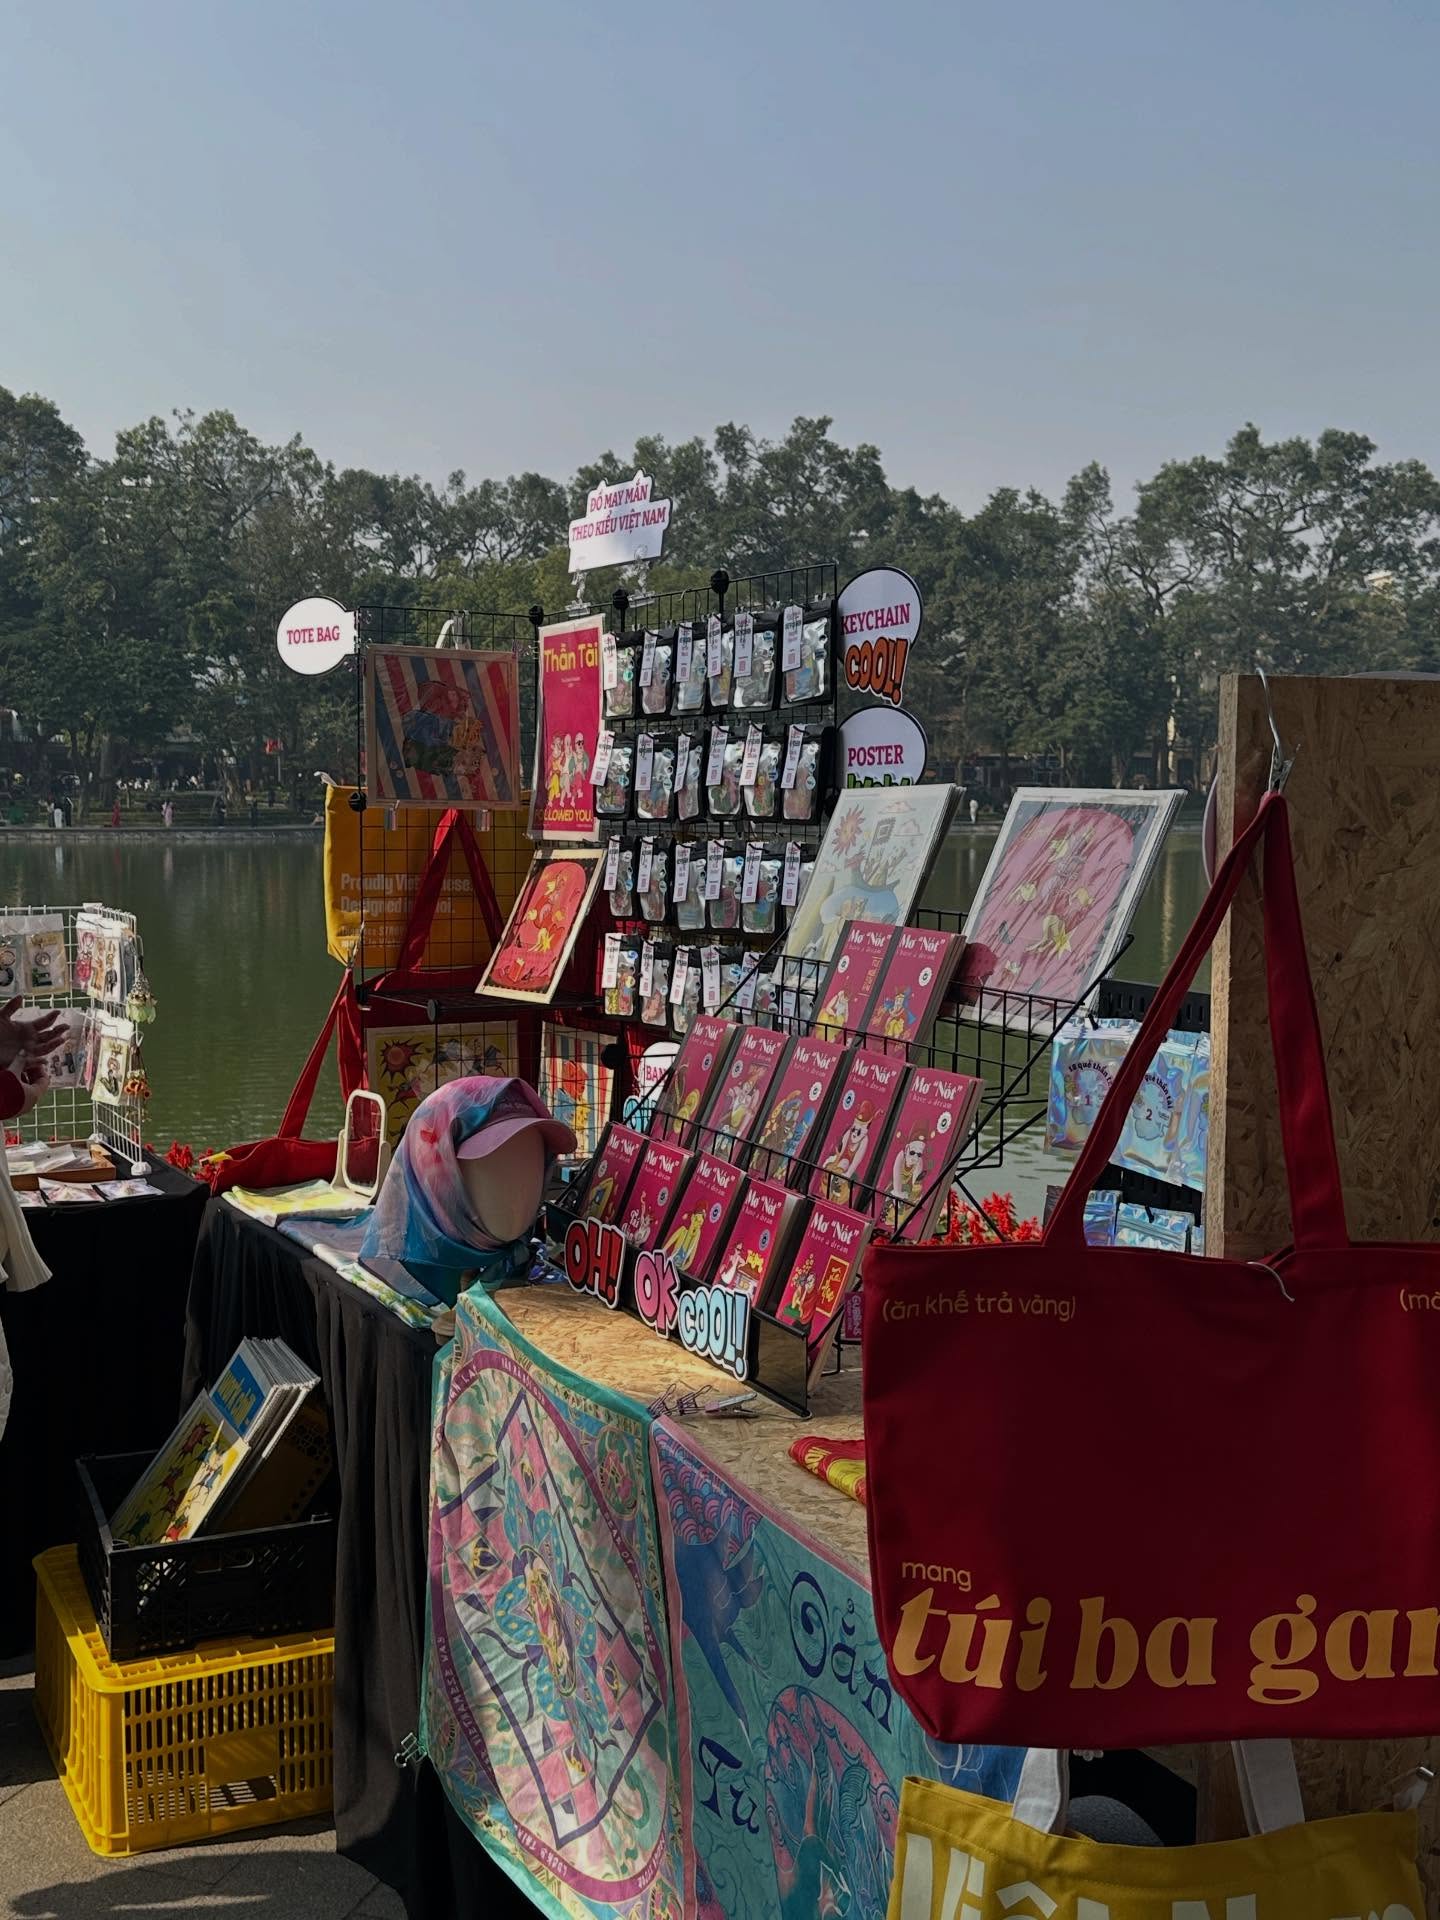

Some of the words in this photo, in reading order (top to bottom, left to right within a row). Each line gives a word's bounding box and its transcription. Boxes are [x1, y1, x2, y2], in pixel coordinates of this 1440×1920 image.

[604, 490, 624, 509] MAY
[572, 523, 594, 541] THEO
[595, 510, 617, 536] KIỂU
[620, 509, 641, 534] VIỆT
[642, 507, 666, 526] NAM
[287, 628, 314, 645] TOTE
[317, 625, 340, 642] BAG
[840, 603, 910, 635] KEYCHAIN
[845, 636, 908, 705] COOL!
[848, 744, 904, 767] POSTER
[341, 873, 393, 895] Proudly
[341, 896, 402, 917] Designed
[1085, 1095, 1093, 1106] 1
[1145, 1109, 1153, 1121] 2
[566, 1220, 624, 1304] OH!
[636, 1252, 678, 1334] OK
[883, 1299, 919, 1322] (ăn
[926, 1290, 969, 1314] khế
[975, 1291, 1013, 1313] trả
[680, 1287, 748, 1378] COOL!
[902, 1561, 971, 1593] mang
[892, 1587, 1051, 1692] túi
[1069, 1596, 1217, 1690] ba
